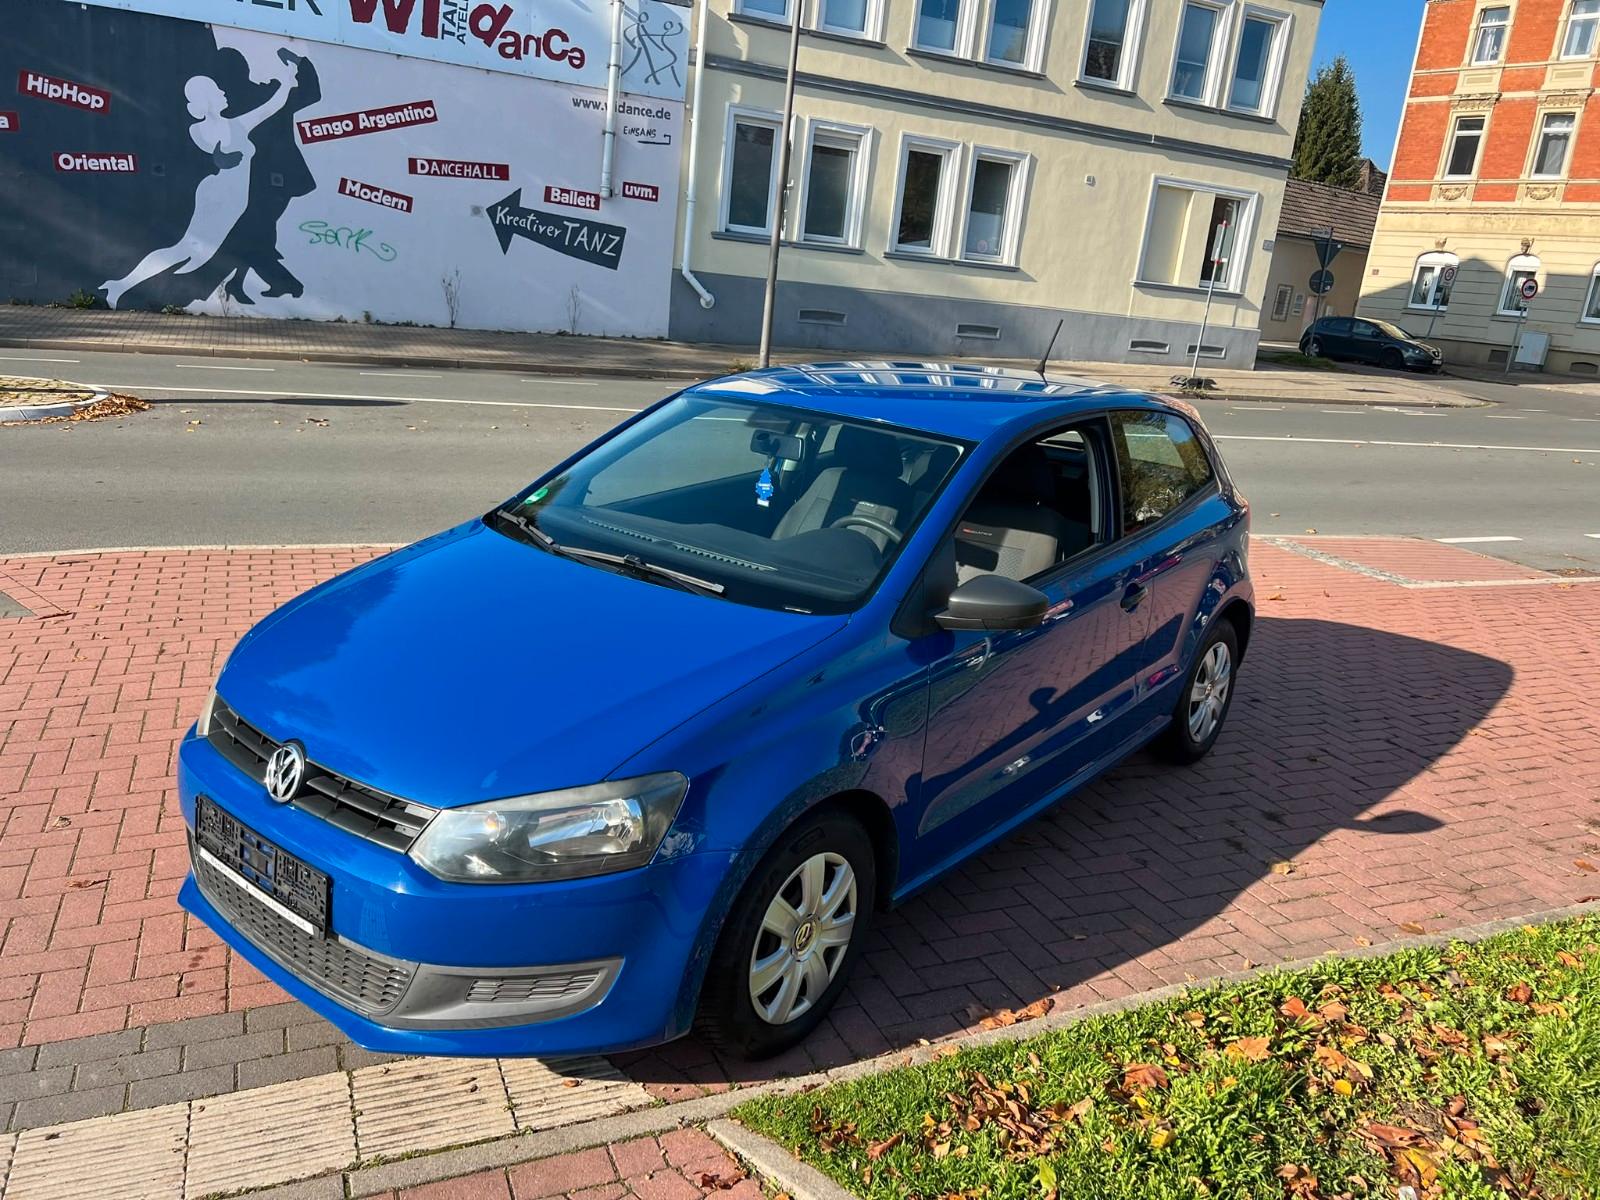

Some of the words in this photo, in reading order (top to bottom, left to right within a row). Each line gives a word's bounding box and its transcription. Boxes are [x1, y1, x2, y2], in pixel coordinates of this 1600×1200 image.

[27, 74, 104, 108] HipHop
[301, 113, 353, 138] Tango
[358, 105, 435, 130] Argentino
[58, 153, 134, 171] Oriental
[416, 159, 500, 179] DANCEHALL
[345, 179, 408, 210] Modern
[550, 187, 596, 208] Ballett
[624, 184, 656, 199] uvm.
[495, 205, 562, 238] Kreativer
[563, 220, 621, 257] TANZ
